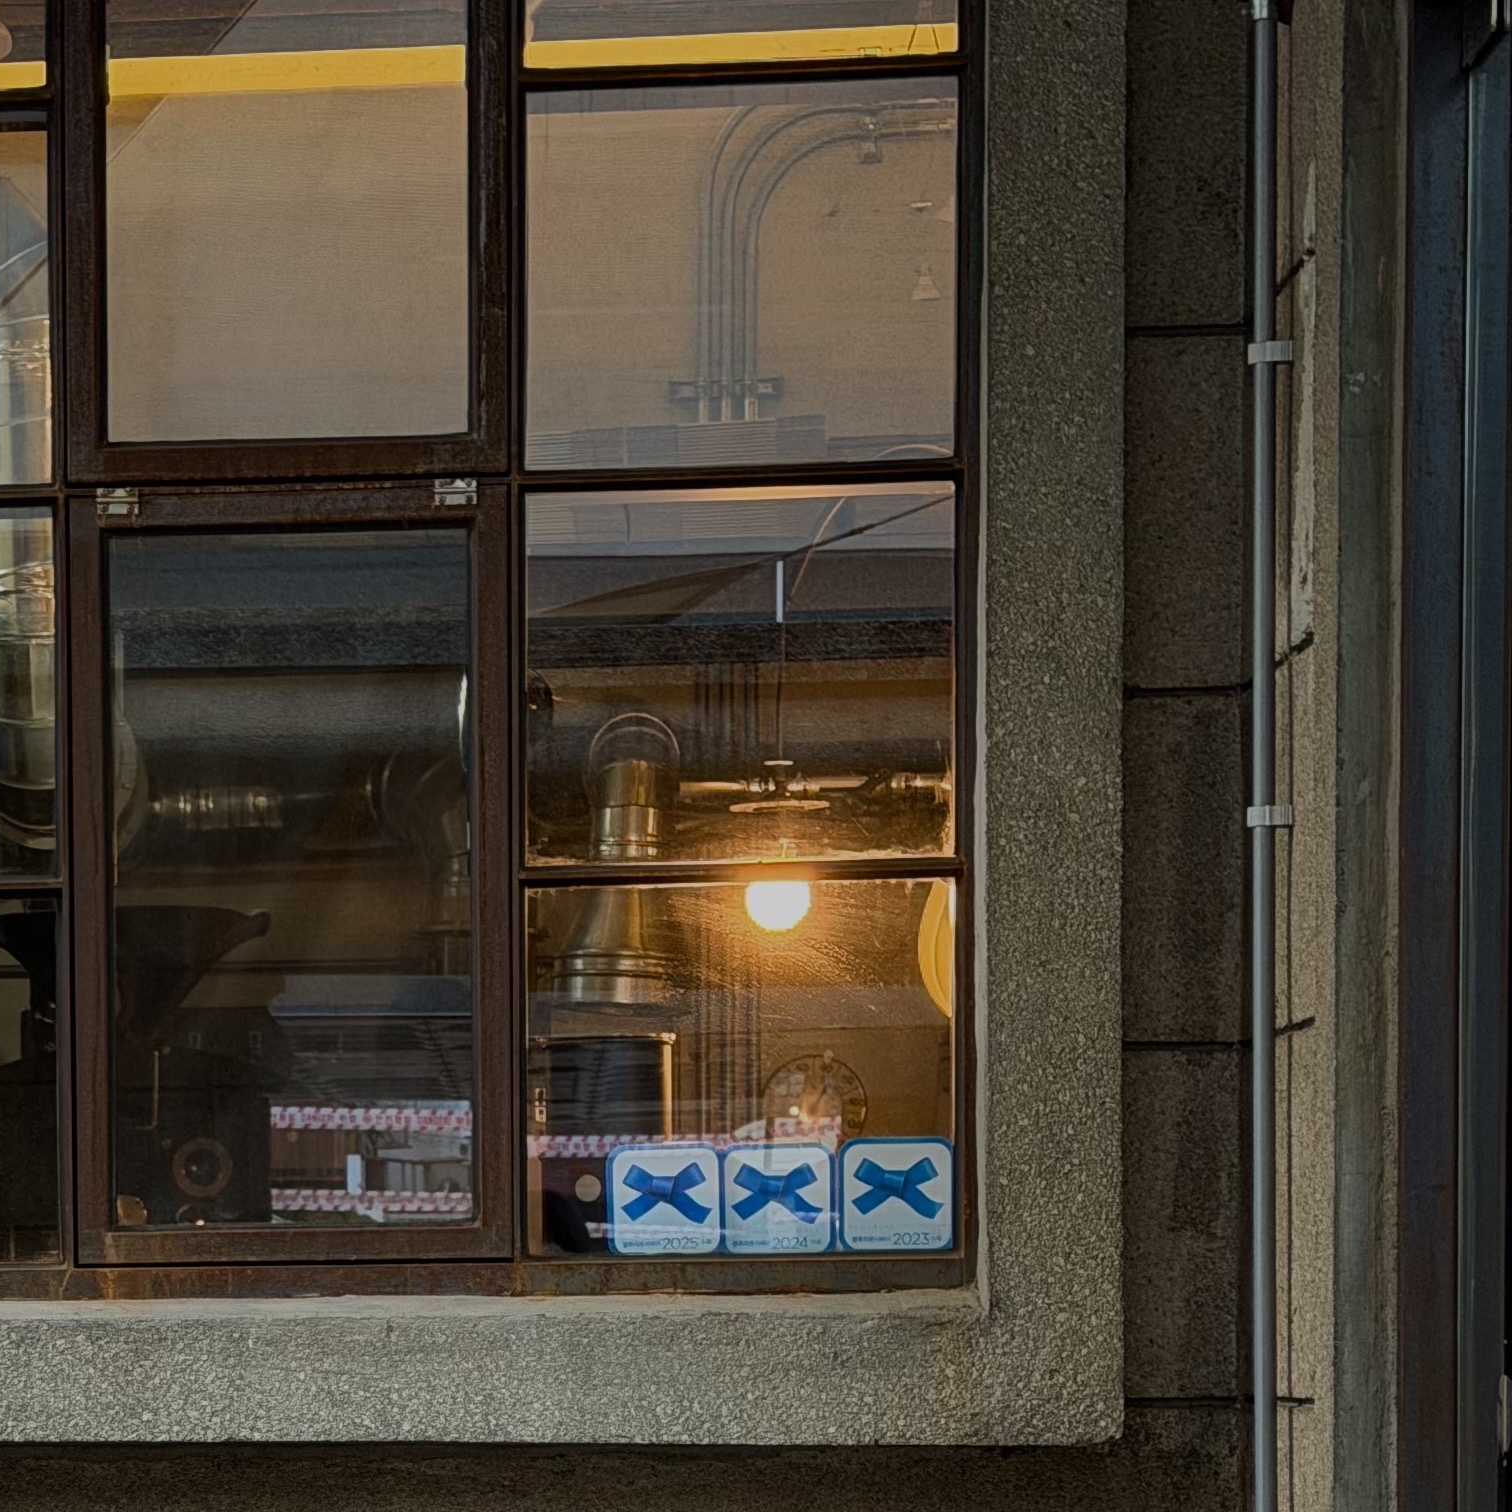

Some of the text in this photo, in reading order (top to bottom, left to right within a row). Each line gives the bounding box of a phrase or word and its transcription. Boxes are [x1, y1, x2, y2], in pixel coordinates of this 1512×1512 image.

[662, 1236, 699, 1250] 2025
[772, 1236, 808, 1250] 2024
[892, 1232, 931, 1246] 2023
